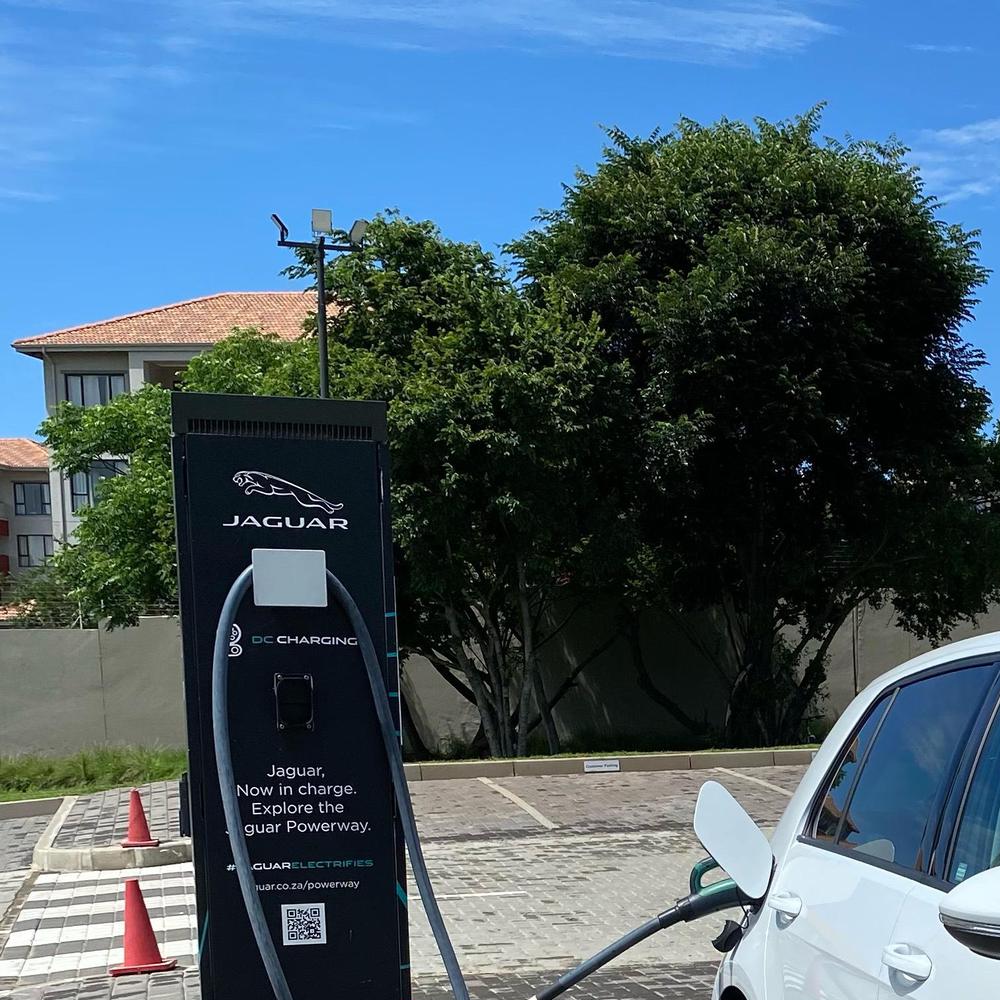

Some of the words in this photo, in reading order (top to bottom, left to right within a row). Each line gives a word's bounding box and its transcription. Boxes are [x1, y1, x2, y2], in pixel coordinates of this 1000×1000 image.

[222, 515, 349, 530] JAGUAR
[252, 635, 274, 644] DC
[276, 635, 358, 646] CHARGING
[267, 765, 325, 779] Jaguar,
[237, 784, 273, 797] Now
[279, 783, 293, 796] in
[298, 783, 357, 798] charge.
[252, 802, 313, 817] Explore
[318, 801, 344, 814] the
[226, 822, 281, 837] guar
[286, 820, 372, 834] Powerway.
[226, 859, 374, 872] #GUARELECTRIFIES
[255, 880, 360, 892] uar.co.za/powerway
